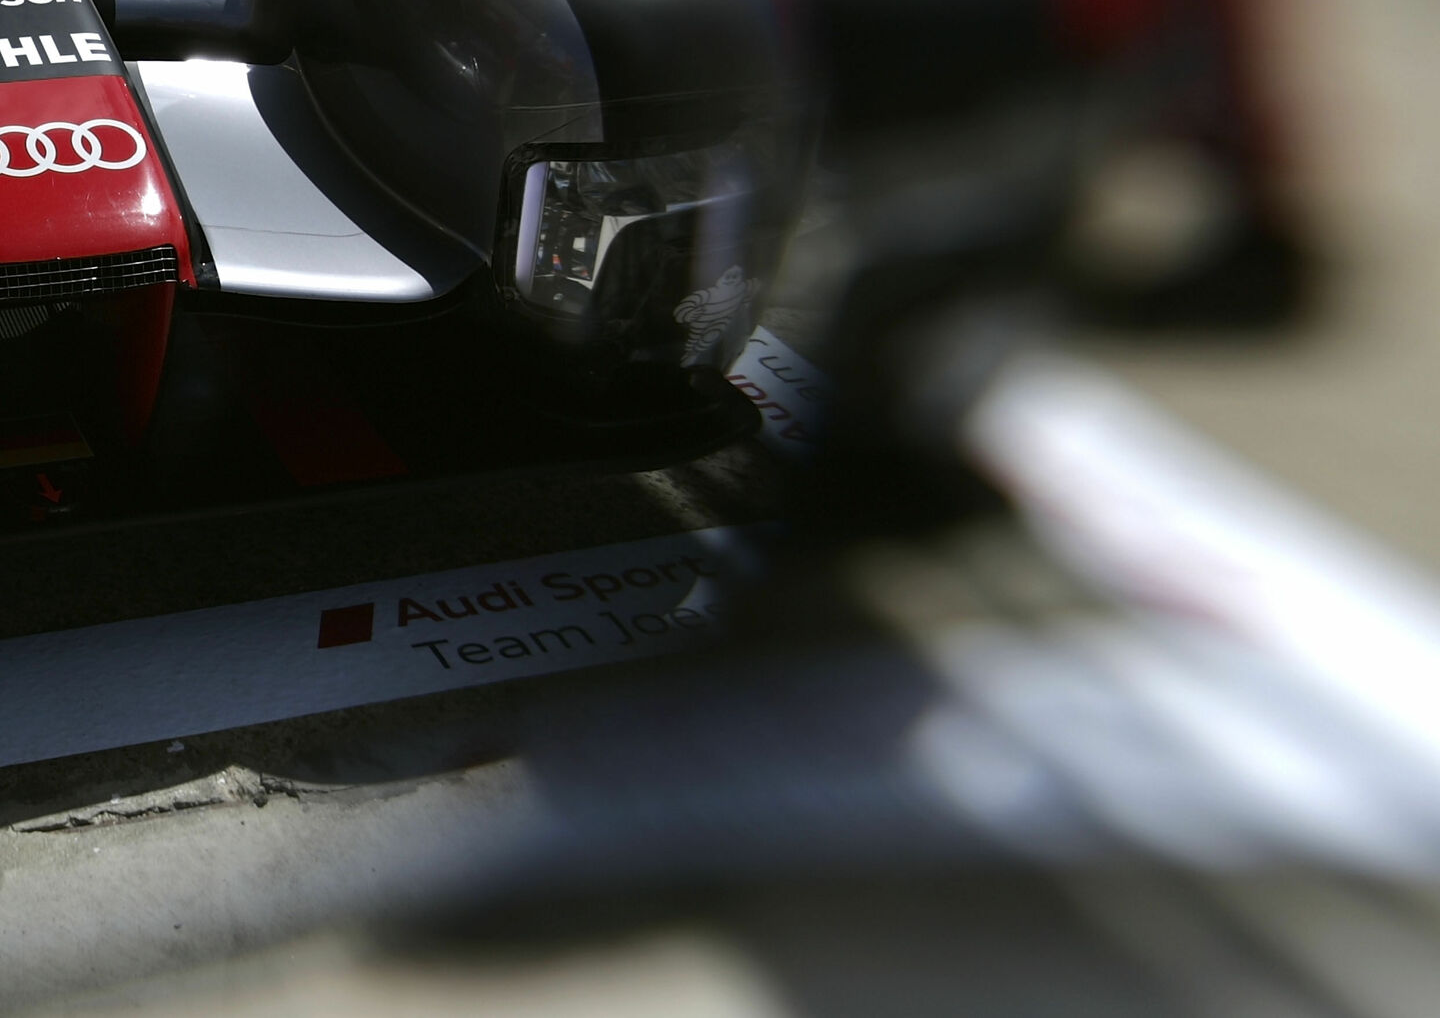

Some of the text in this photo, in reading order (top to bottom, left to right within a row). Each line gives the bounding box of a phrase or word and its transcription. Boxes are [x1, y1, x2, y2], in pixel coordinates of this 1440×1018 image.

[397, 554, 718, 627] Audi Sport
[411, 623, 596, 669] Team
